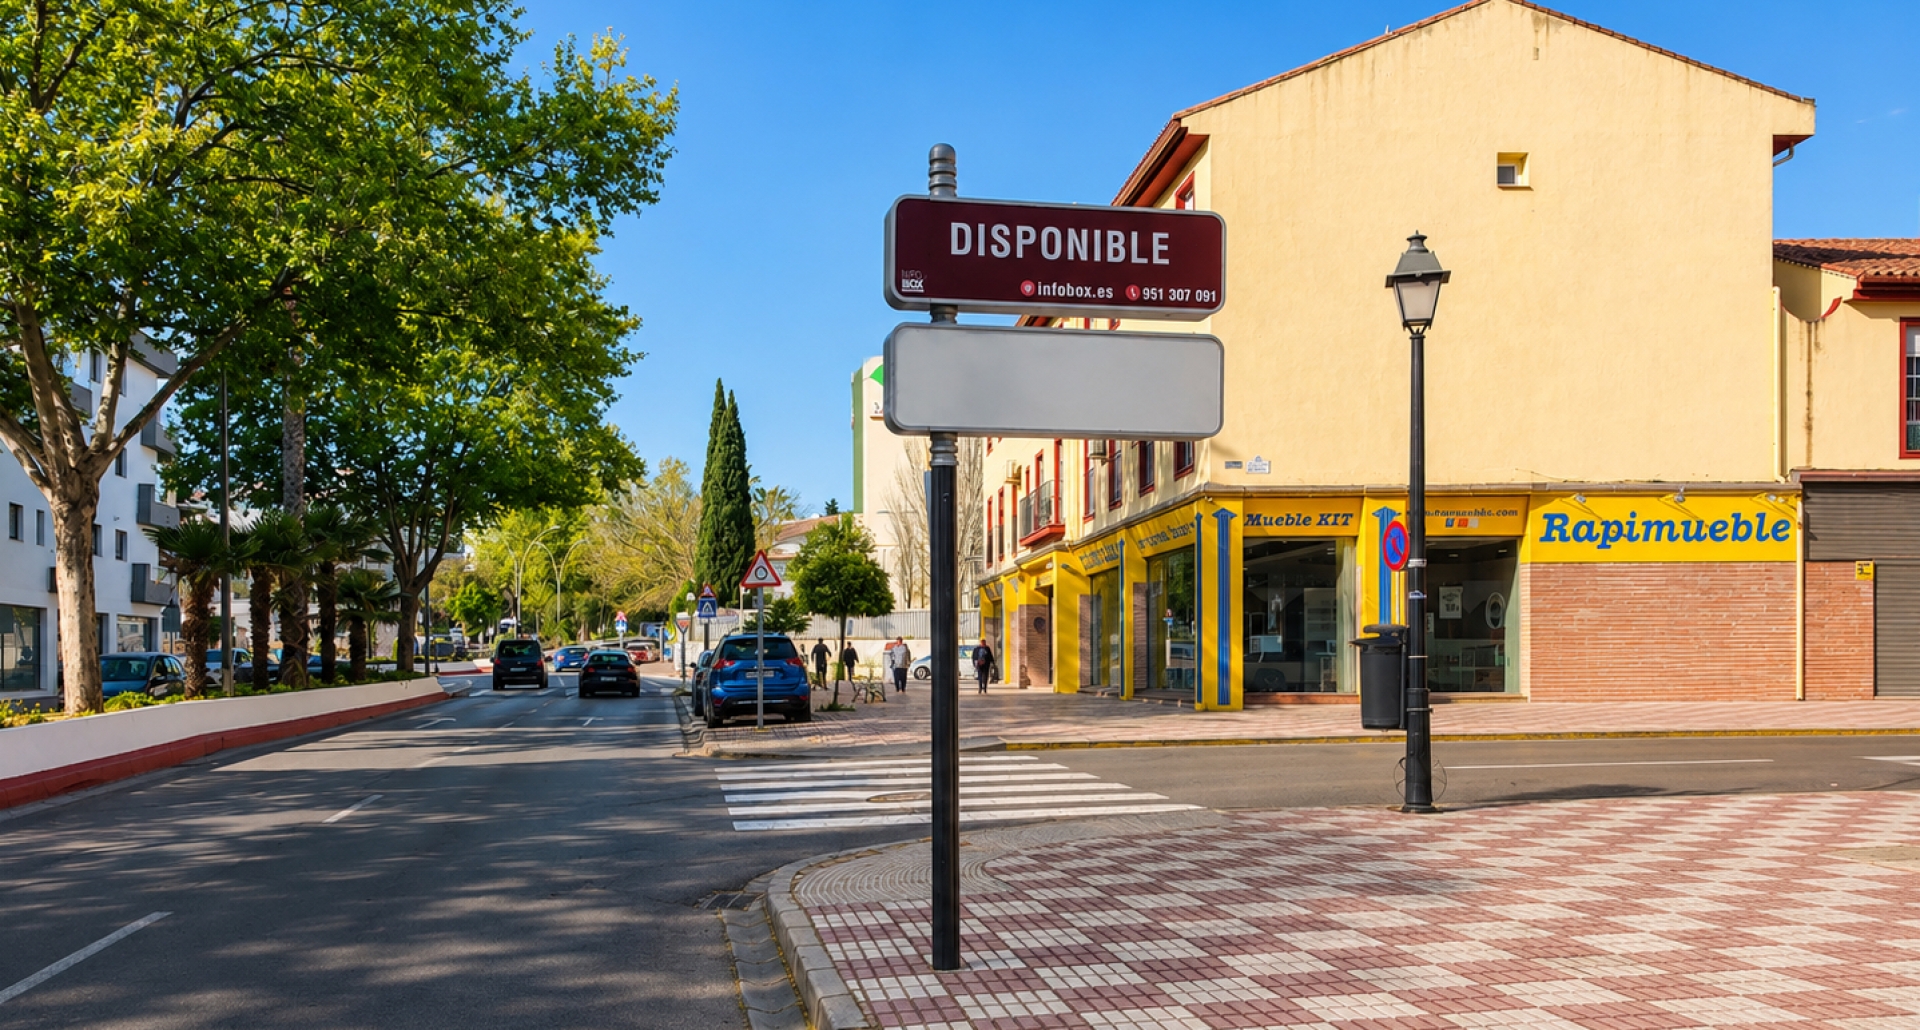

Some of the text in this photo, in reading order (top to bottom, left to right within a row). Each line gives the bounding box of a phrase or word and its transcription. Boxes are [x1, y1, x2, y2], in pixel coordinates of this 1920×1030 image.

[950, 222, 1170, 265] DISPONIBLE
[1037, 281, 1114, 299] infobox.es
[1143, 287, 1216, 302] 951 307 091
[1244, 513, 1354, 526] Mueble KIT
[1539, 511, 1790, 549] Rapimueble
